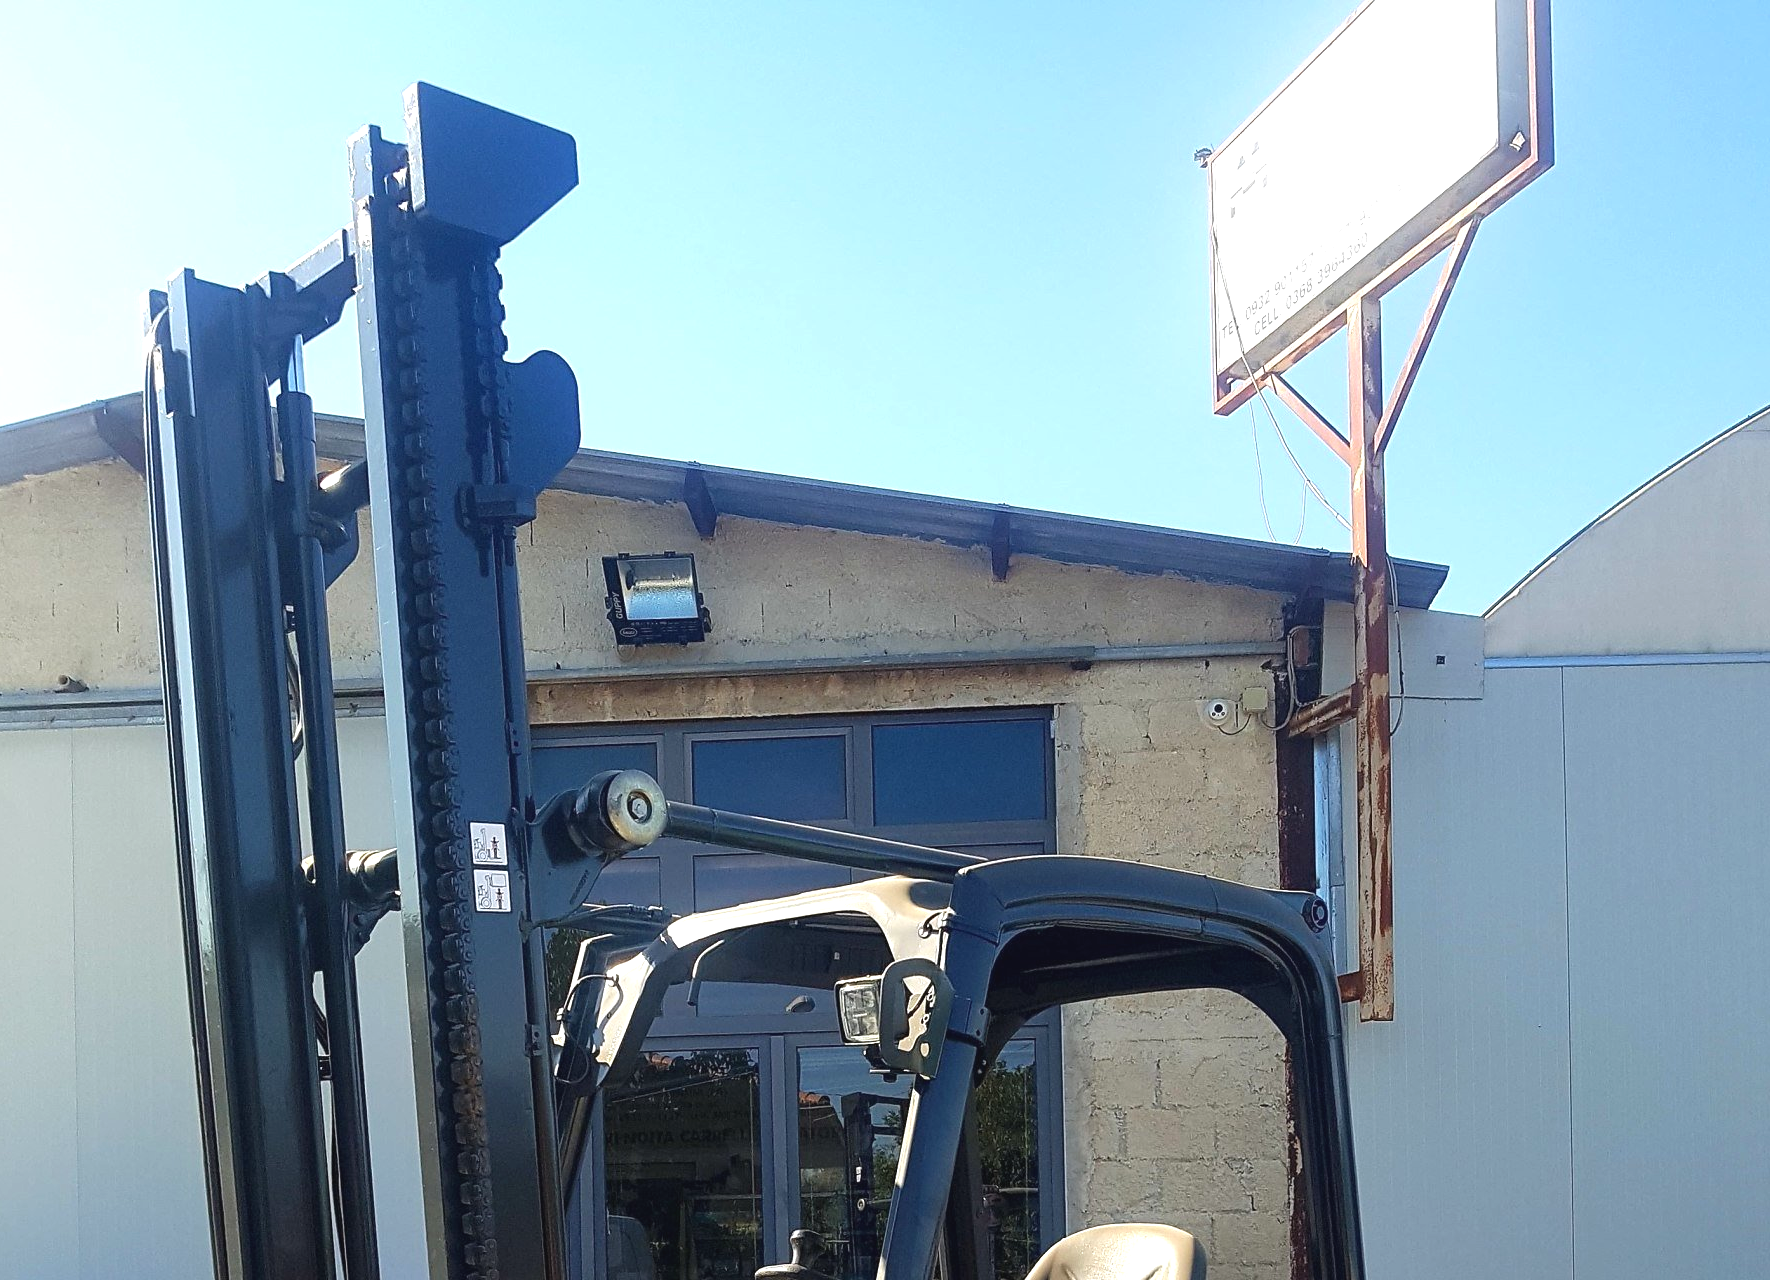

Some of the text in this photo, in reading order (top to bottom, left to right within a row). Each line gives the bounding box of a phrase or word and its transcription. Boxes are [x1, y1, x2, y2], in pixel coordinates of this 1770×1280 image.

[1286, 280, 1313, 310] 0368
[1222, 318, 1242, 340] TE.
[1245, 289, 1271, 321] 0932
[612, 592, 623, 619] GUPPY
